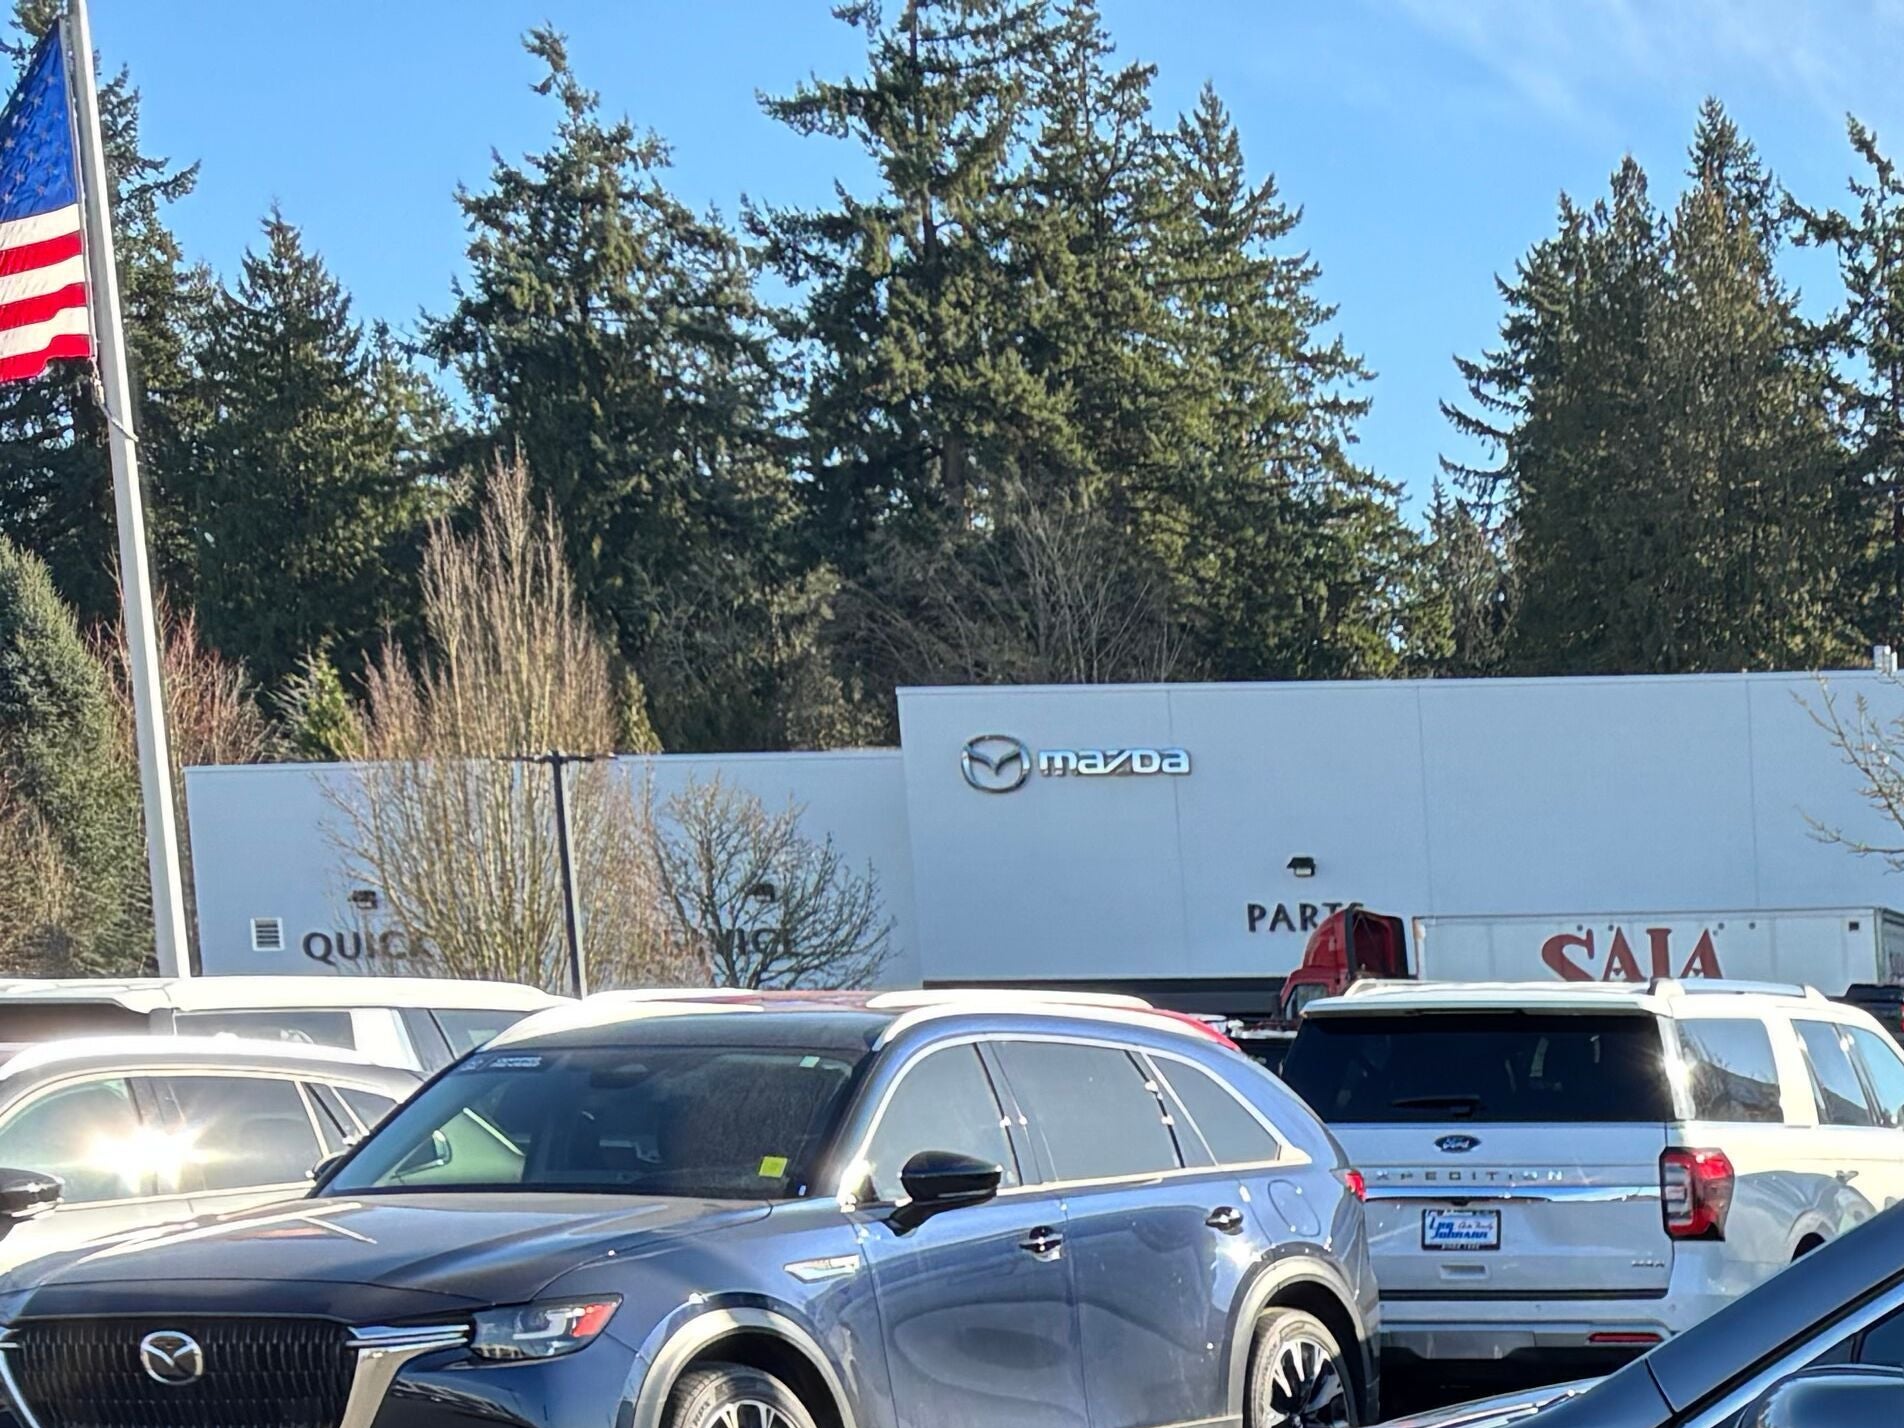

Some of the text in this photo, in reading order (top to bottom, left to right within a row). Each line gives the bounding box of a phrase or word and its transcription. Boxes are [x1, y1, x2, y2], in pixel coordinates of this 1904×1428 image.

[1039, 749, 1192, 776] mazda
[1247, 902, 1364, 932] PART
[1541, 926, 1723, 982] SAIA
[1377, 1170, 1562, 1182] XPEDITION
